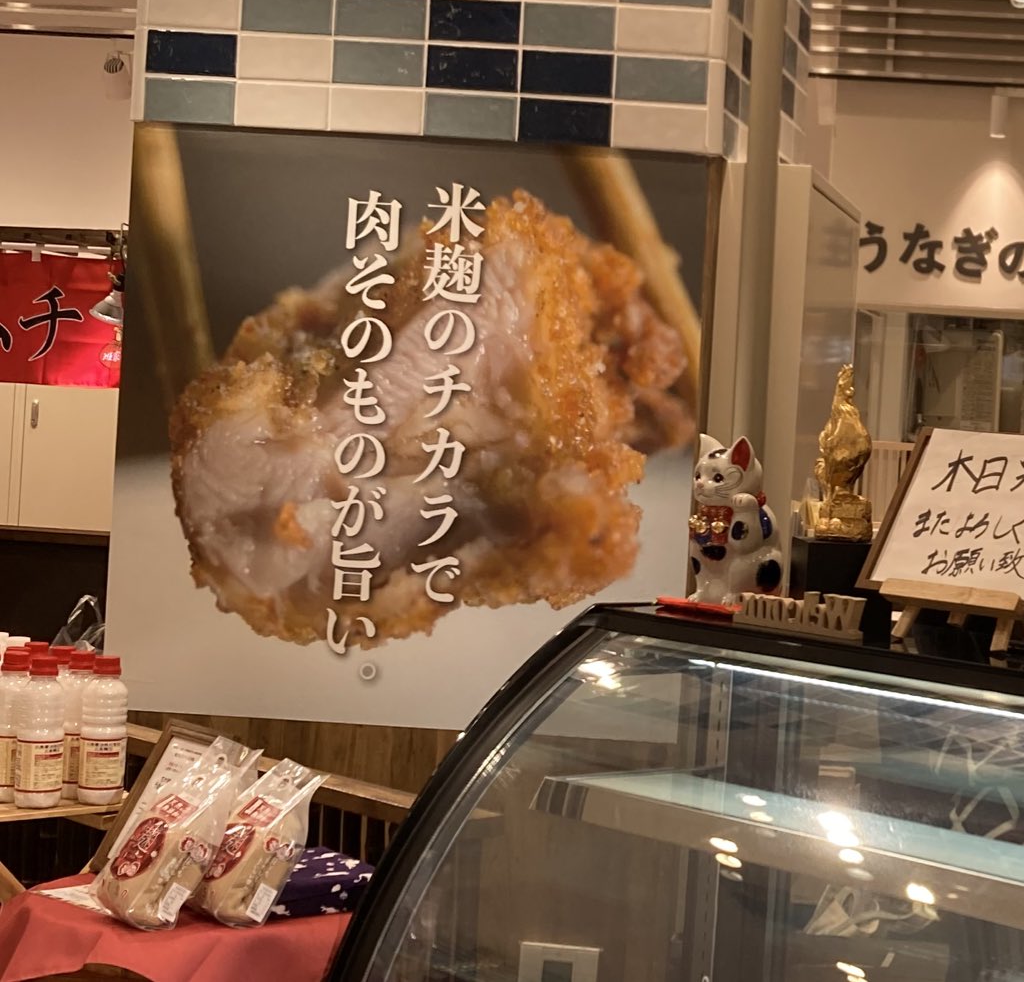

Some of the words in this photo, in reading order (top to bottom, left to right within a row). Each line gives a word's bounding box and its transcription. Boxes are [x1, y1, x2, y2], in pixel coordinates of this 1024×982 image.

[0, 285, 84, 362] チ
[325, 190, 403, 681] 肉そのものが旨い。
[410, 183, 486, 604] 米麹のチカラで
